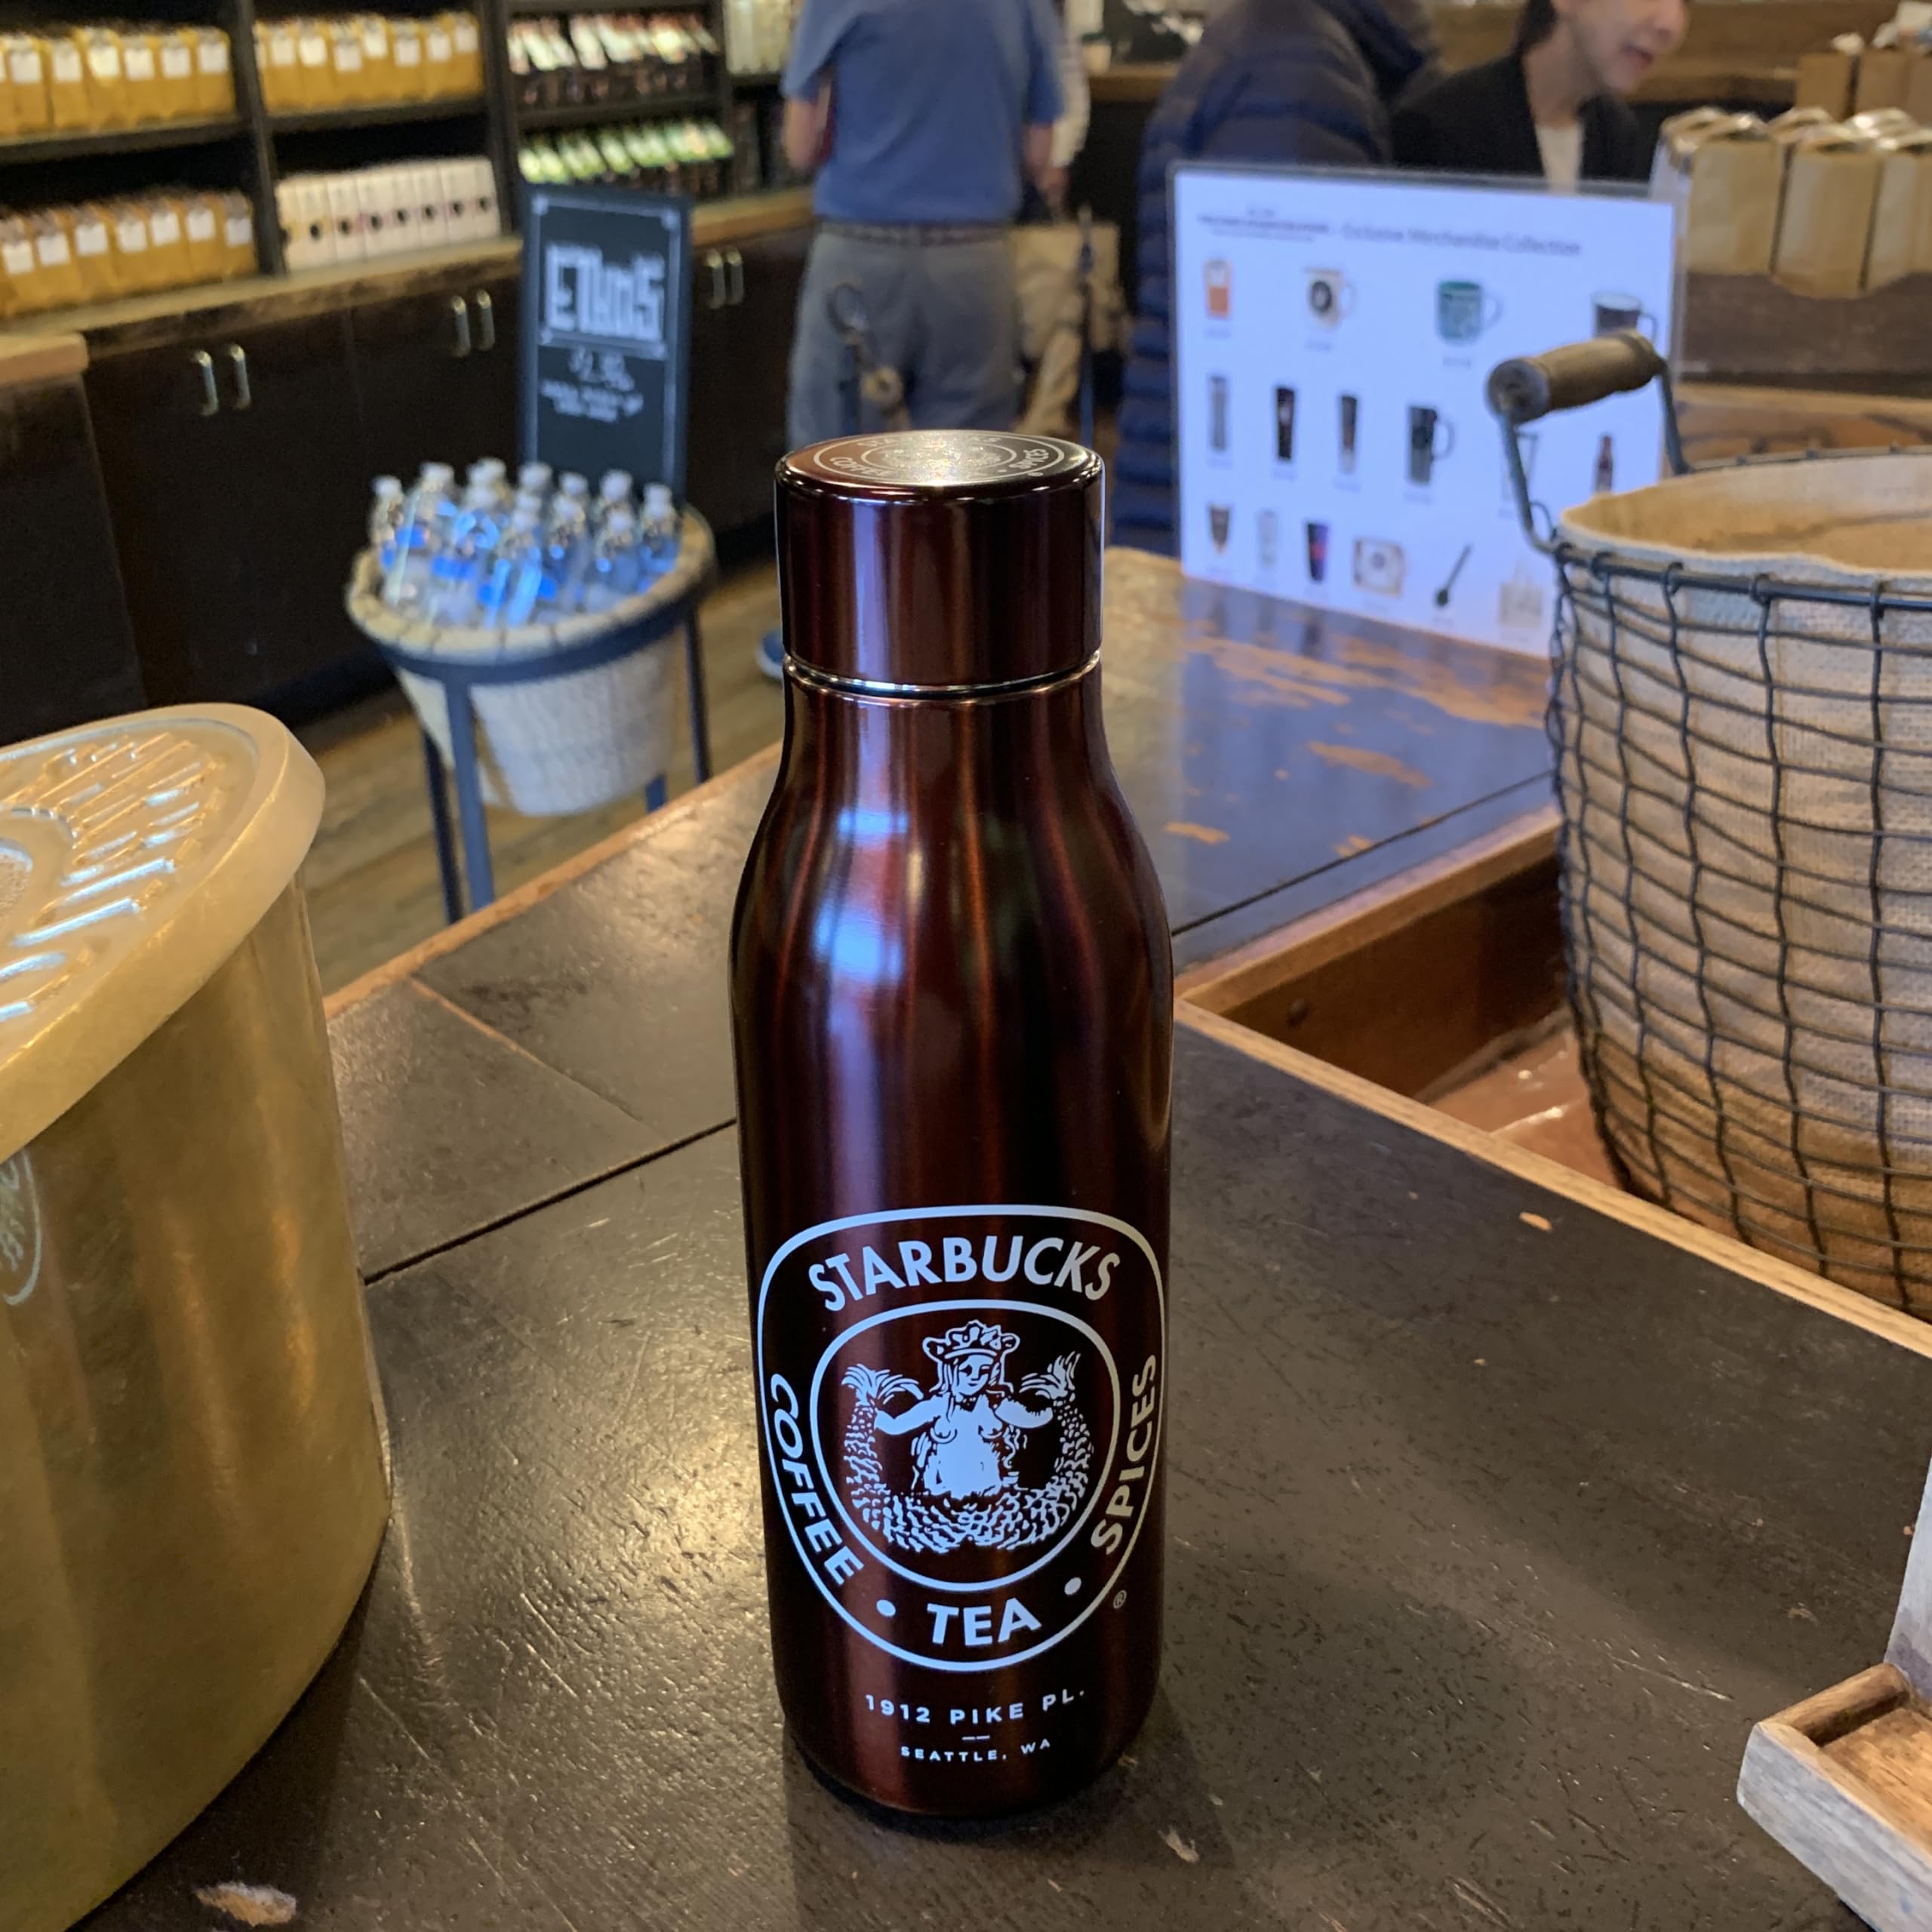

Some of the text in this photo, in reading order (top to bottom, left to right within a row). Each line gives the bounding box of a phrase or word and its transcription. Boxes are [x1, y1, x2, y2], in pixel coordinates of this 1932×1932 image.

[808, 1235, 1121, 1312] STARBUCKS
[770, 1373, 865, 1586] COFFEE
[1090, 1355, 1157, 1555] SPICES
[927, 1598, 1041, 1647] TEA
[865, 1688, 1085, 1725] 1912 PIKE PL.
[1020, 1737, 1051, 1755] WA
